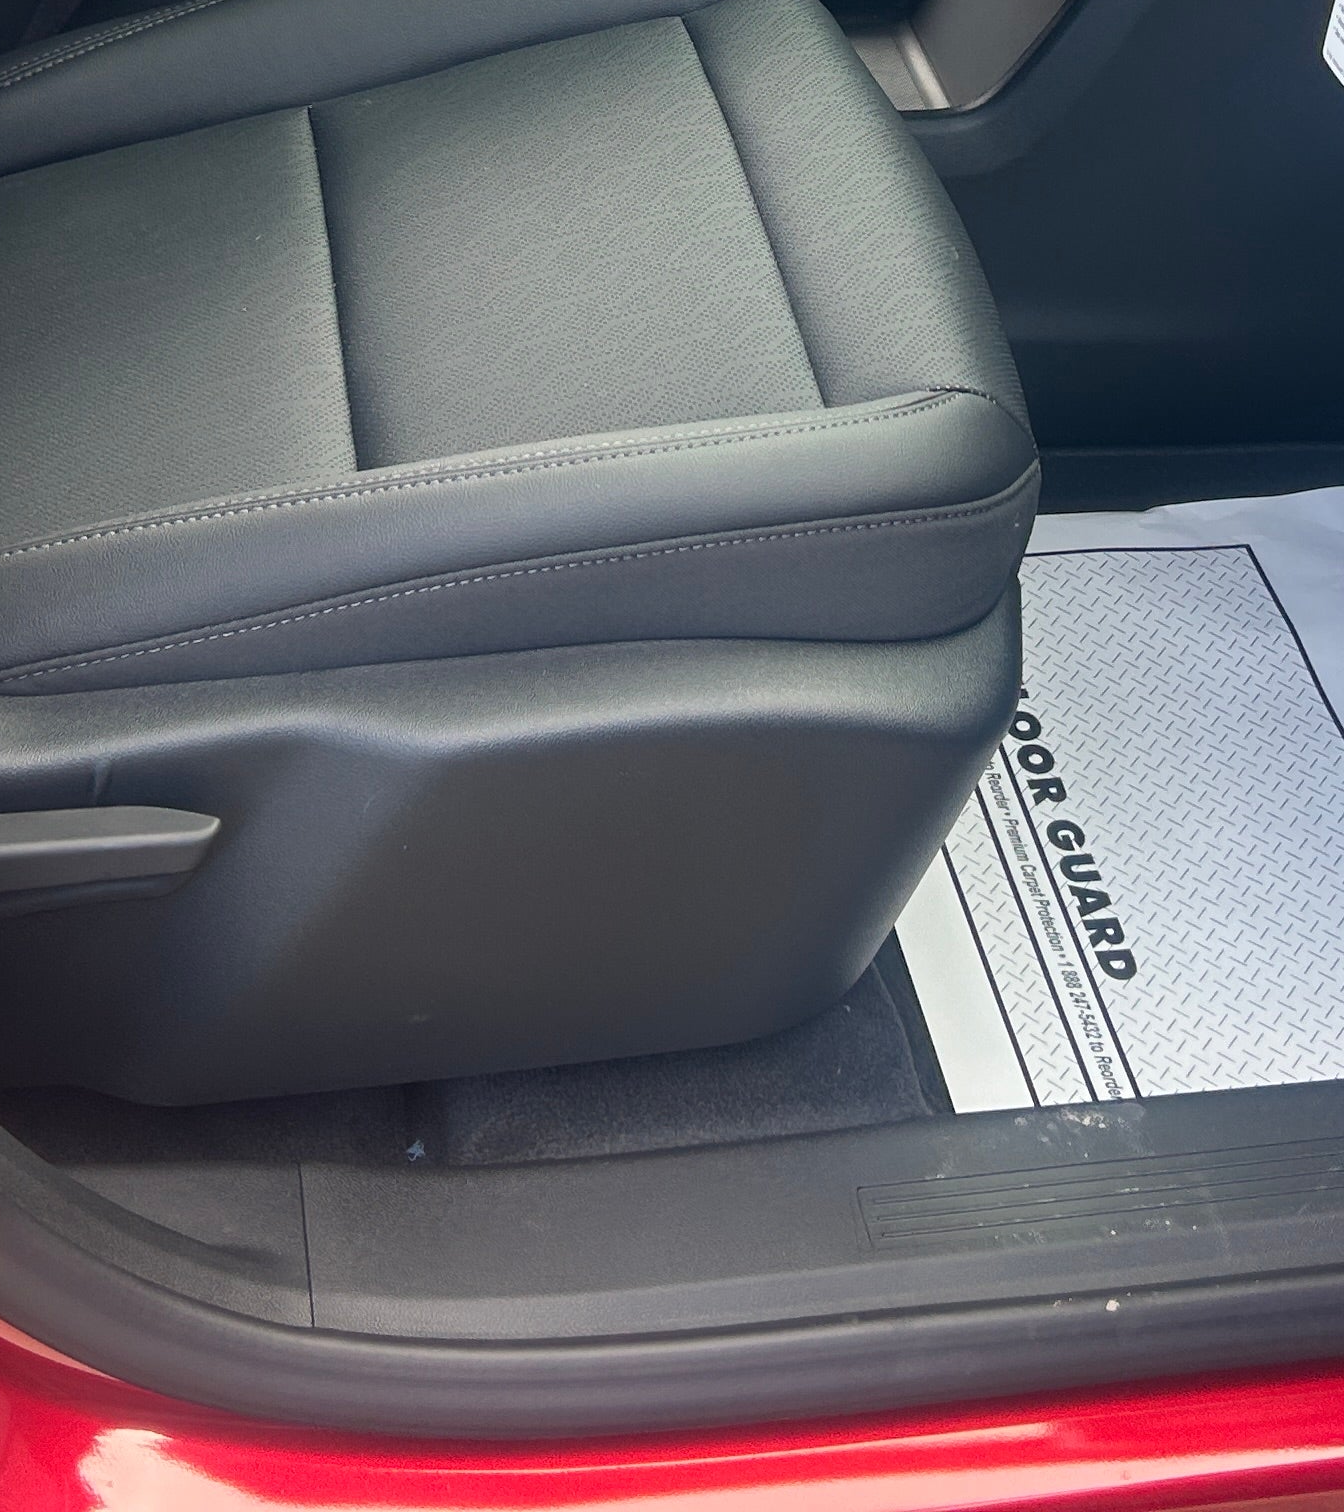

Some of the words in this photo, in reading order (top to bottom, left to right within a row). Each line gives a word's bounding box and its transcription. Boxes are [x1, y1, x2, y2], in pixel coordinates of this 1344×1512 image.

[985, 773, 1010, 812] Reorder
[1002, 818, 1029, 862] Premium
[1008, 688, 1067, 806] OOR
[1047, 819, 1137, 981] GUARD
[1020, 864, 1046, 897] Carpet
[1032, 899, 1065, 951] Protection
[1061, 970, 1083, 989] 888
[1069, 991, 1103, 1039] 247-5432
[1088, 1041, 1105, 1053] to
